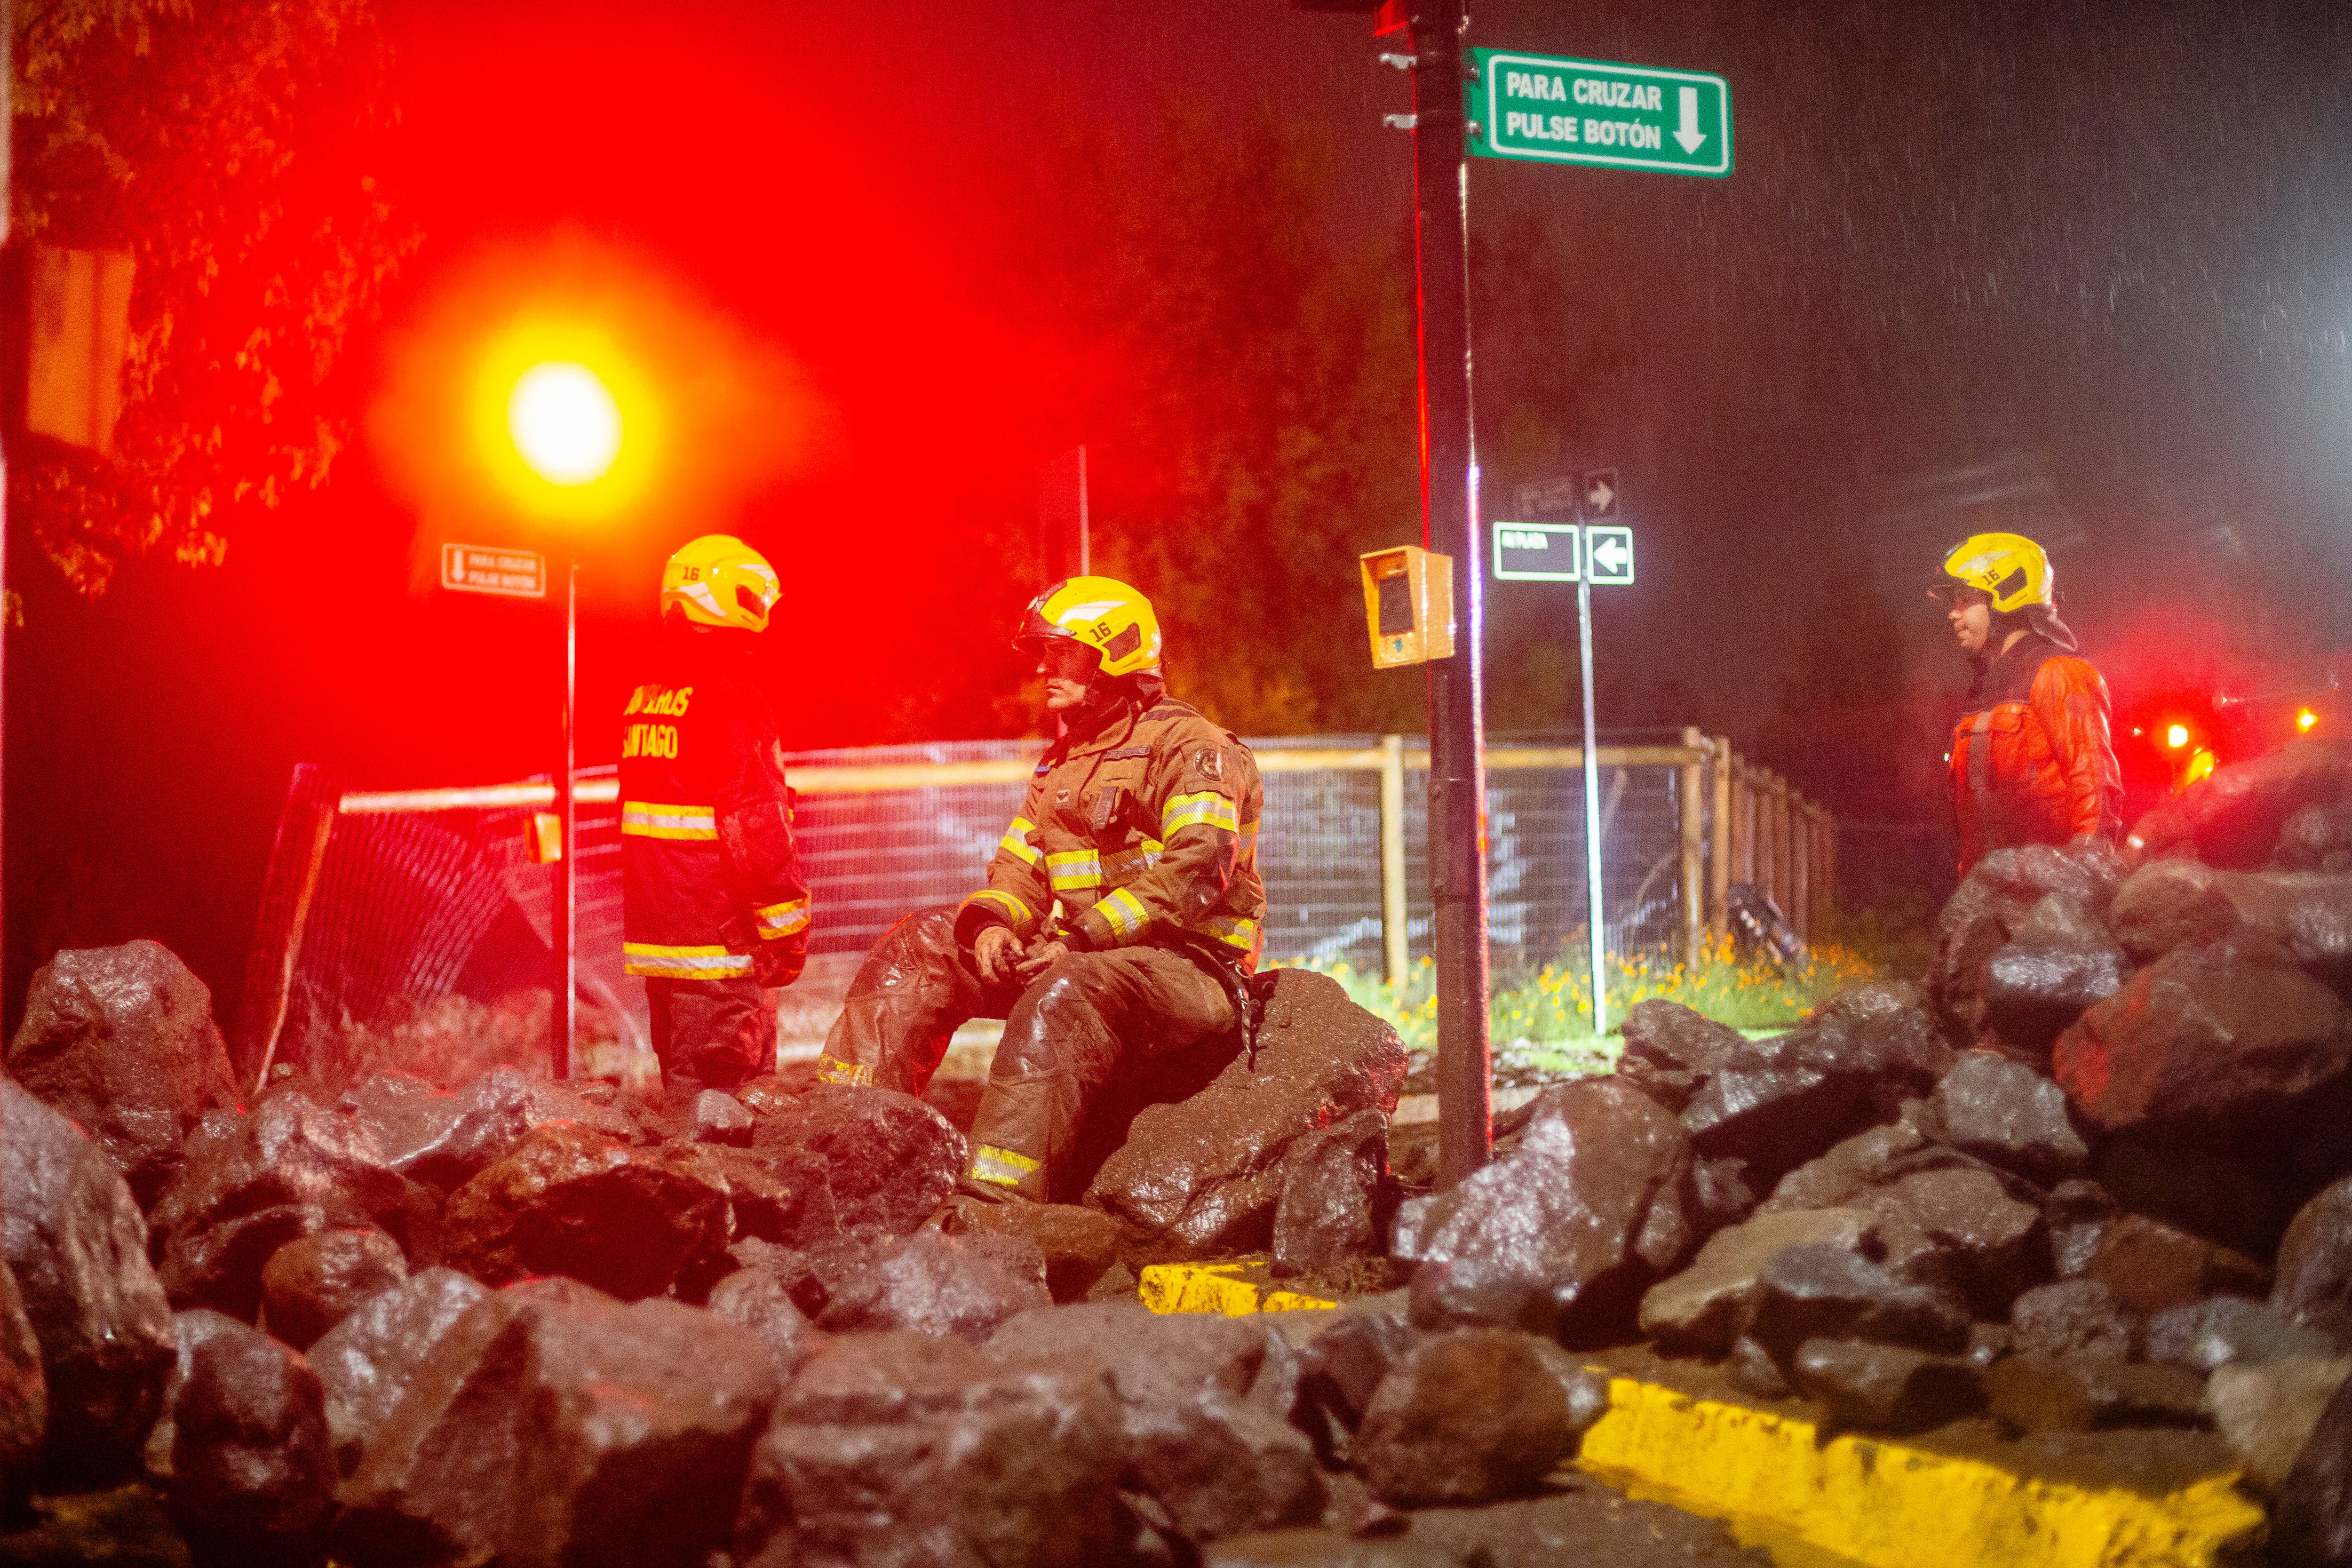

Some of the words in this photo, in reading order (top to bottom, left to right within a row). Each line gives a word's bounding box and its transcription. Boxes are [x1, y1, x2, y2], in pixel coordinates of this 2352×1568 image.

[1506, 71, 1566, 102] PARA
[1573, 79, 1663, 111] CRUZAR
[1507, 111, 1579, 142] PULSE
[1584, 118, 1661, 149] BOTÓN
[682, 566, 700, 581] 16
[1981, 568, 2001, 586] 16
[1089, 621, 1112, 643] 16
